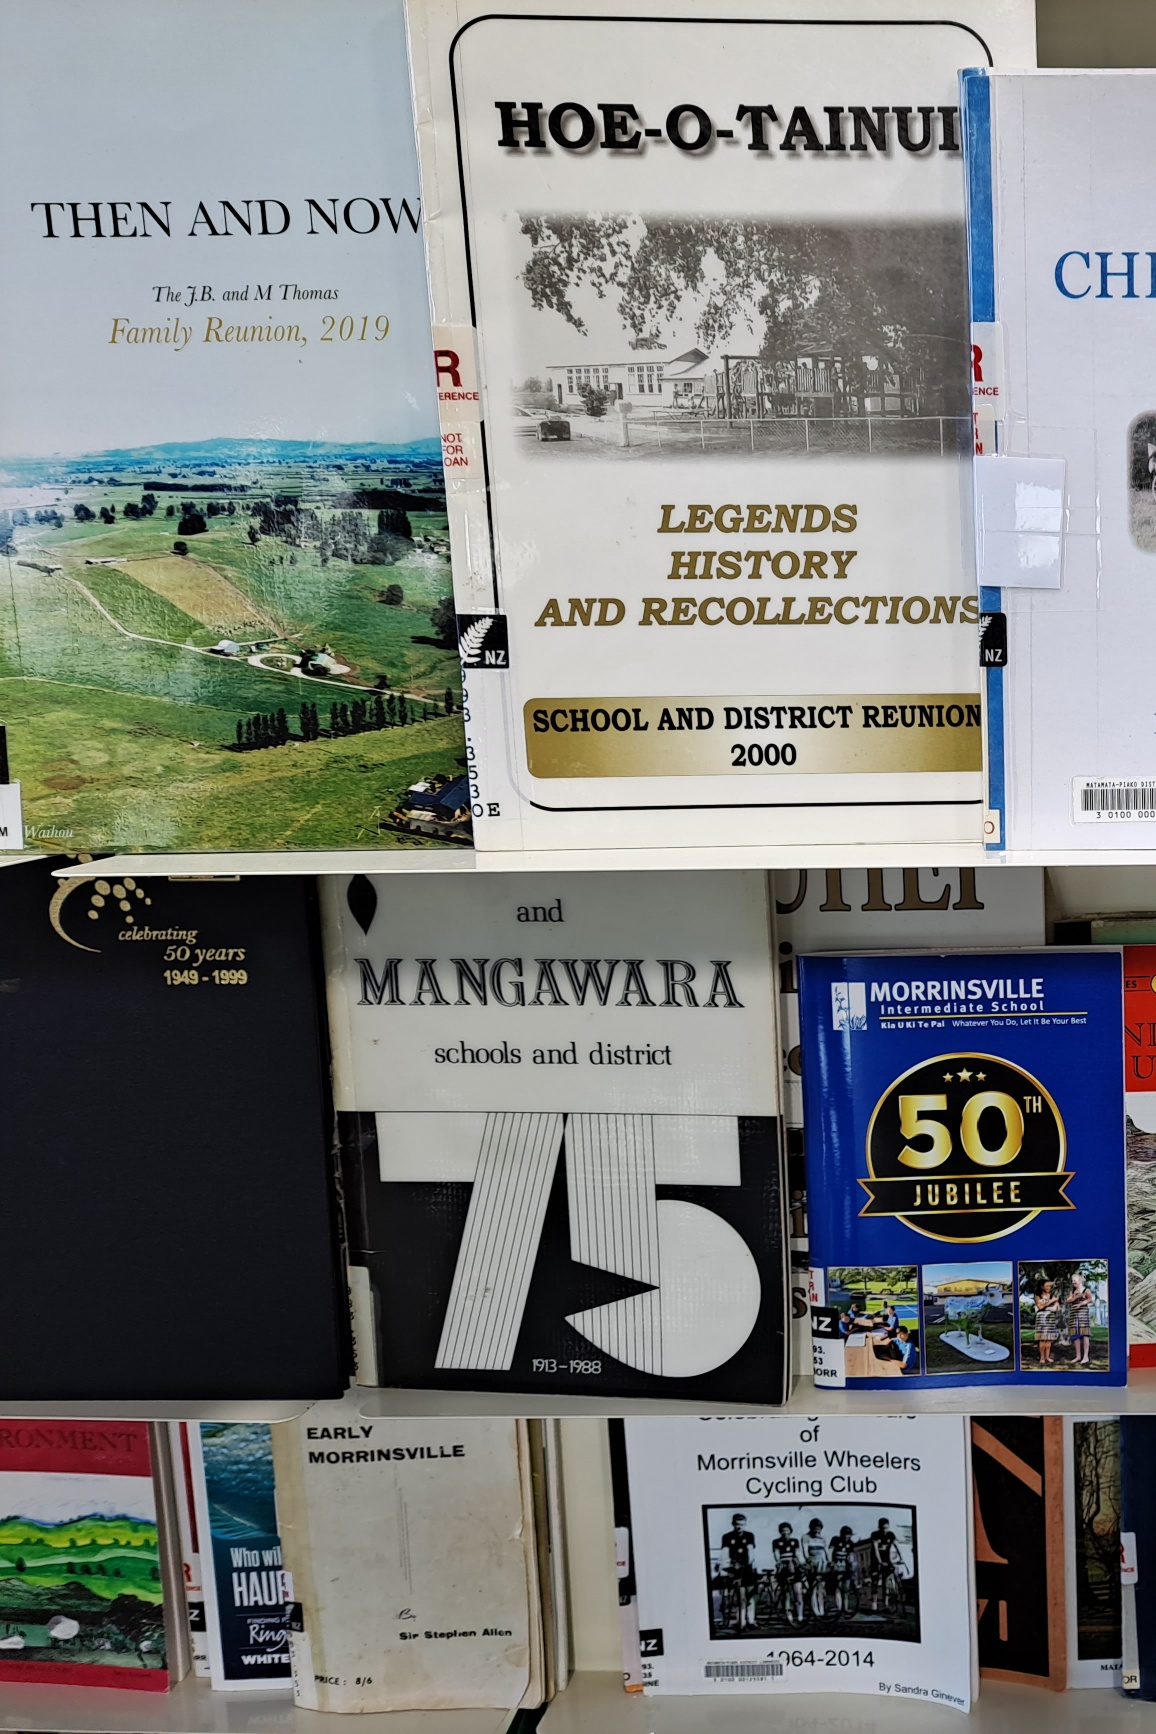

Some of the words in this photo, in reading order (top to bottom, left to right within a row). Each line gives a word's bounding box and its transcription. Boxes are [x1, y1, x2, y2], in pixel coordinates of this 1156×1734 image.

[494, 101, 963, 151] HOE-O-TAINUI
[31, 201, 172, 238] THEN
[188, 199, 291, 237] AND
[304, 197, 422, 235] NOW
[152, 286, 181, 302] The
[184, 285, 216, 307] J.B.
[222, 285, 249, 301] and
[254, 284, 272, 301] M
[279, 283, 339, 301] Thomas
[108, 317, 192, 351] Family
[203, 316, 308, 346] Reunion,
[320, 315, 390, 343] 2019
[657, 504, 857, 533] LEGENDS
[668, 551, 857, 579] HISTORY
[535, 598, 626, 626] AND
[638, 596, 980, 626] RECOLLECTIONS
[533, 709, 648, 733] SCHOOL
[657, 707, 714, 730] AND
[724, 705, 852, 730] DISTRICT
[862, 704, 981, 728] REUNION
[731, 744, 797, 766] 2000
[1108, 811, 1132, 819] 0100
[516, 898, 565, 923] and
[118, 926, 198, 944] celebrating
[163, 946, 190, 961] 50
[193, 947, 246, 966] years
[163, 969, 199, 985] 1949
[211, 969, 248, 985] 1999
[354, 957, 745, 1008] MANGAWARA
[870, 978, 1044, 1002] MORRINSVILLE
[881, 1002, 984, 1015] Intermediate
[991, 1001, 1044, 1012] School
[897, 1021, 905, 1029] U
[918, 1020, 929, 1028] Te
[952, 1019, 988, 1028] Whatever
[990, 1019, 1004, 1027] You
[1005, 1018, 1019, 1027] Do,
[1020, 1018, 1031, 1026] Let
[1033, 1017, 1039, 1025] It
[1052, 1017, 1068, 1025] Your
[434, 1040, 522, 1066] schools
[532, 1041, 578, 1065] and
[588, 1042, 673, 1066] district
[897, 1090, 1025, 1170] 50
[1023, 1096, 1042, 1113] TH
[913, 1181, 1021, 1207] JUBILEE
[375, 1112, 762, 1378] 75
[531, 1358, 602, 1375] 1913-1988
[307, 1426, 373, 1440] EARLY
[800, 1425, 820, 1443] of
[308, 1445, 465, 1464] MORRINSVILLE
[697, 1451, 817, 1472] Morrinsville
[823, 1450, 921, 1471] Wheelers
[746, 1477, 823, 1498] Cycling
[830, 1475, 878, 1494] Club
[230, 1547, 260, 1568] Who
[248, 1624, 288, 1652] Ring
[399, 1631, 419, 1641] Sir
[424, 1628, 477, 1640] Stephen
[241, 1654, 290, 1665] WHITE
[314, 1676, 340, 1686] PRICE
[355, 1677, 373, 1687] 8/6
[878, 1682, 892, 1694] By
[894, 1683, 929, 1697] Sandra
